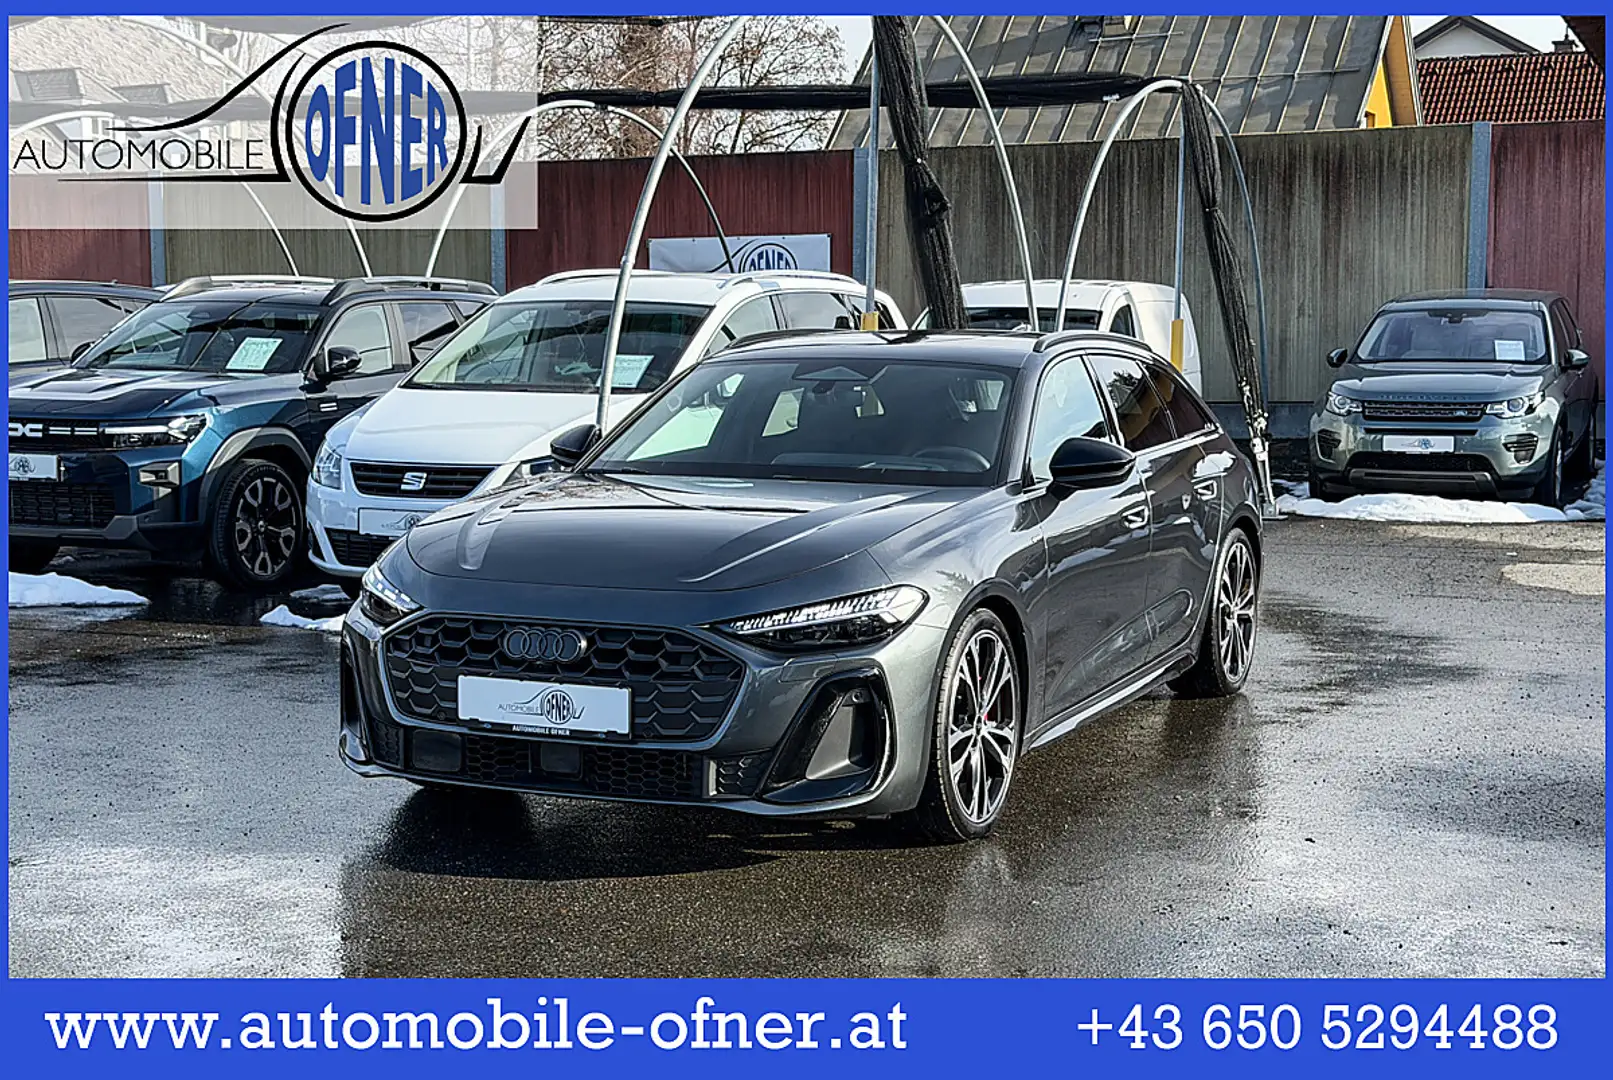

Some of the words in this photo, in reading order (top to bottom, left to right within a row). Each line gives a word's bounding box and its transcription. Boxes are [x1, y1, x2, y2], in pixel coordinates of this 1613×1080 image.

[546, 693, 571, 721] OFNER
[512, 725, 550, 734] AUTOMOBILE
[551, 728, 570, 736] OFNER
